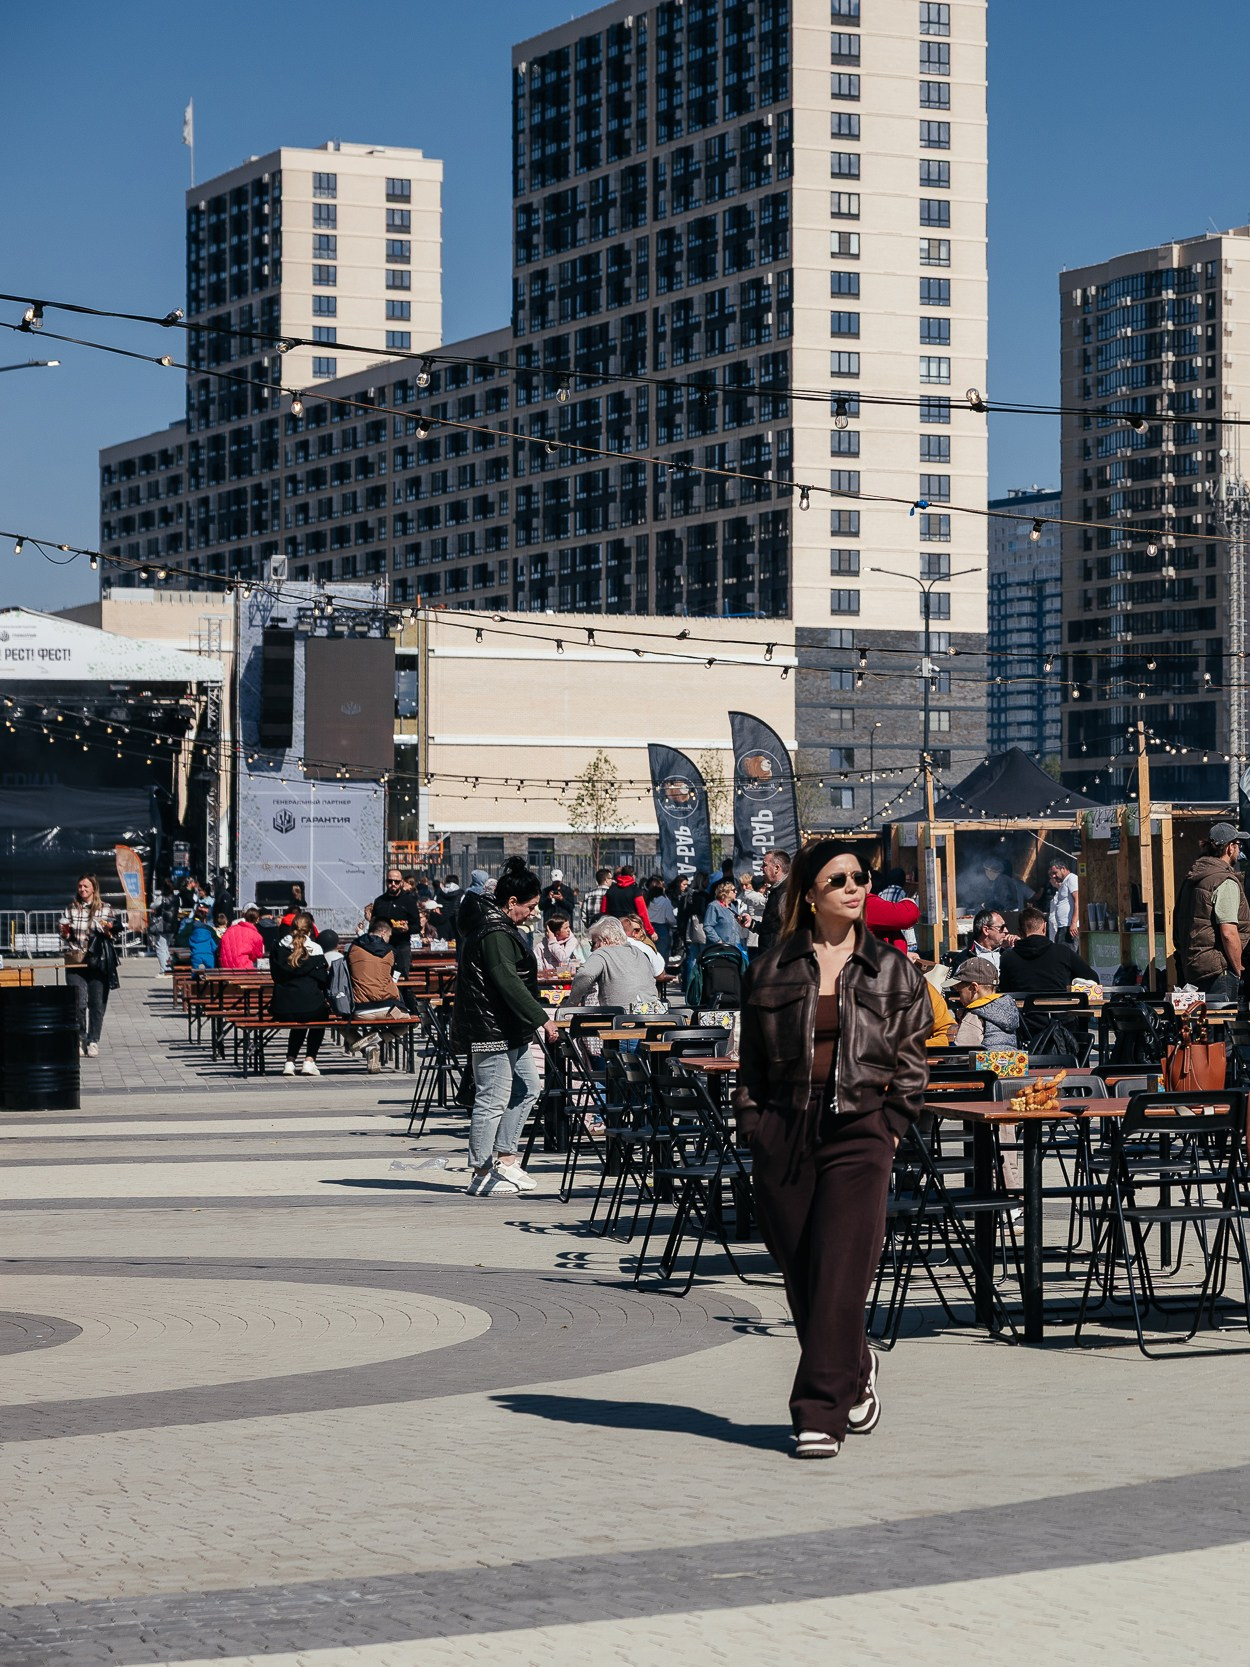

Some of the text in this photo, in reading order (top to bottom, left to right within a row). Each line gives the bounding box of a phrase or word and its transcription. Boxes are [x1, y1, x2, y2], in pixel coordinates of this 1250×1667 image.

[4, 648, 71, 661] РЕСТ! ФЕСТ!
[300, 816, 351, 824] ГАРАНТИЯ
